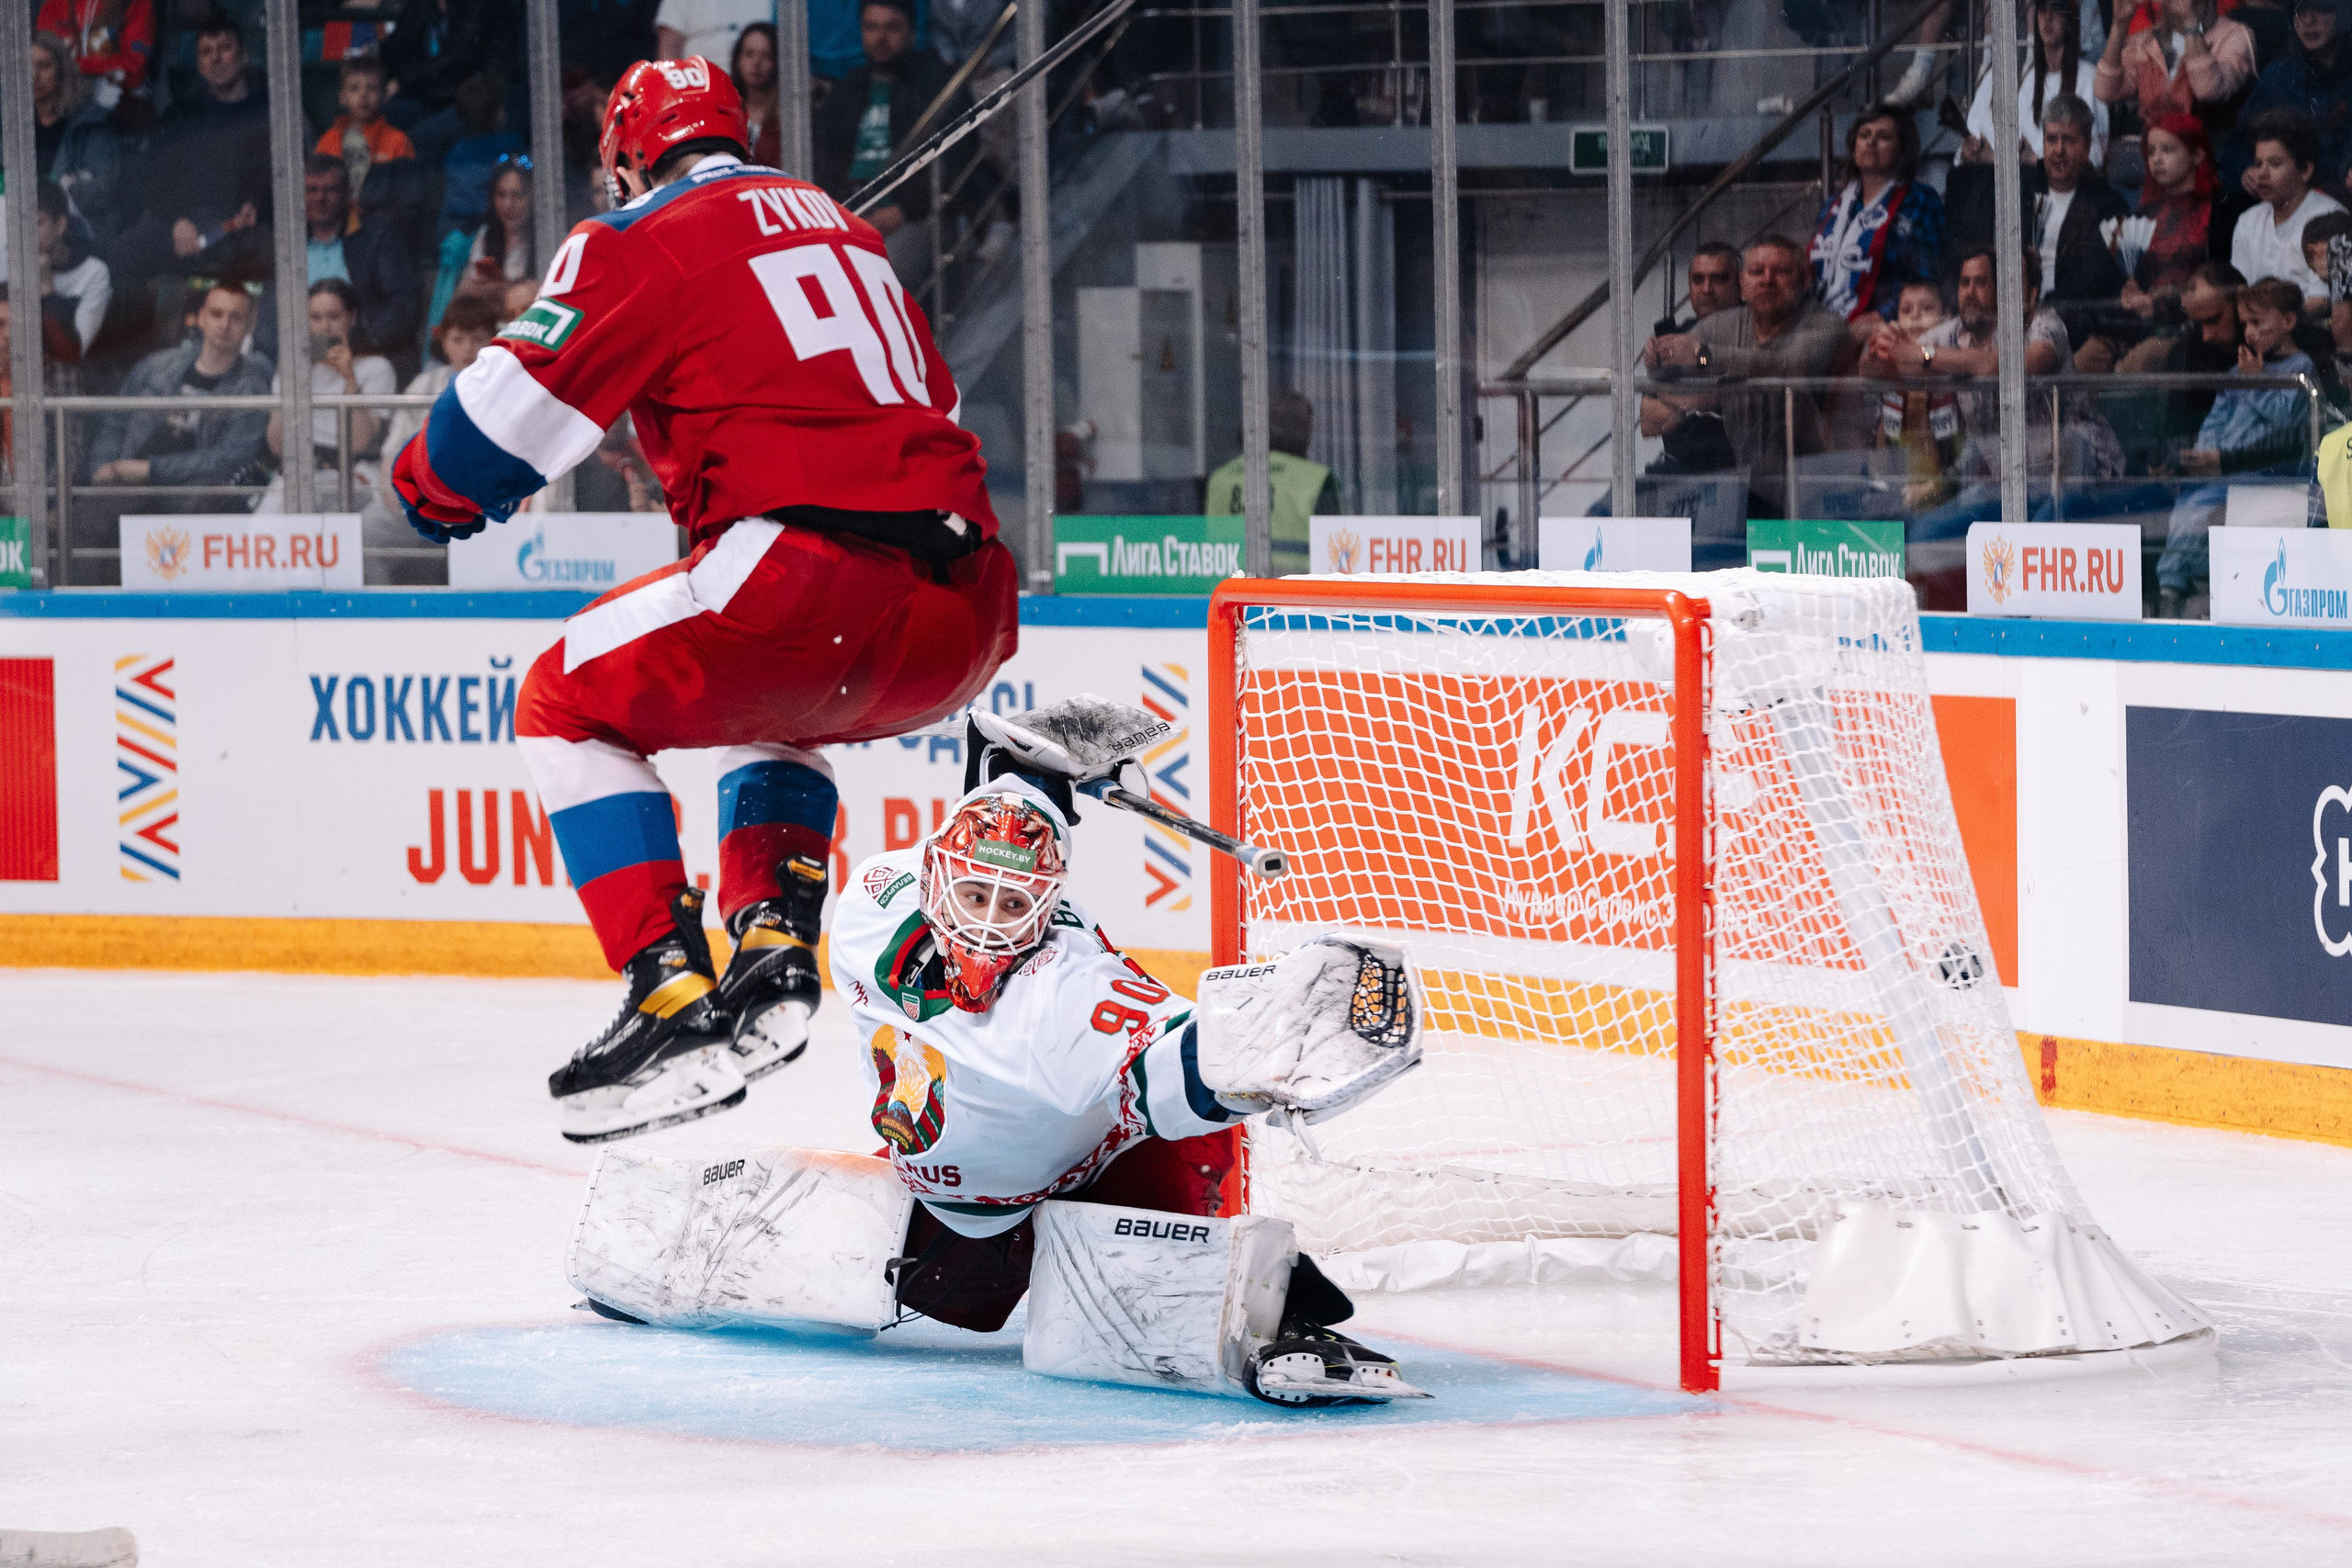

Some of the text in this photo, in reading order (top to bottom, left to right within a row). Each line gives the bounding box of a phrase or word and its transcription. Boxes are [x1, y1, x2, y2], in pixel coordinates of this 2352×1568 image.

[665, 67, 706, 90] 90
[737, 186, 850, 236] ZYKOV
[536, 233, 590, 299] 0
[747, 243, 932, 407] 90
[202, 534, 340, 570] FHR.RU
[1370, 537, 1466, 573] FHR.RU
[2021, 547, 2124, 593] FHR.RU
[2289, 589, 2348, 619] ГАЗПРОМ
[309, 656, 516, 743] ХОККЕЙ
[1111, 722, 1171, 751] BAUER
[978, 844, 1032, 863] HOCKEY.BY
[879, 874, 913, 905] БЕЛАРУСЬ
[1205, 964, 1277, 981] BAUER
[1090, 979, 1171, 1036] 90
[703, 1158, 745, 1186] BAUER
[1114, 1217, 1211, 1244] BAUER
